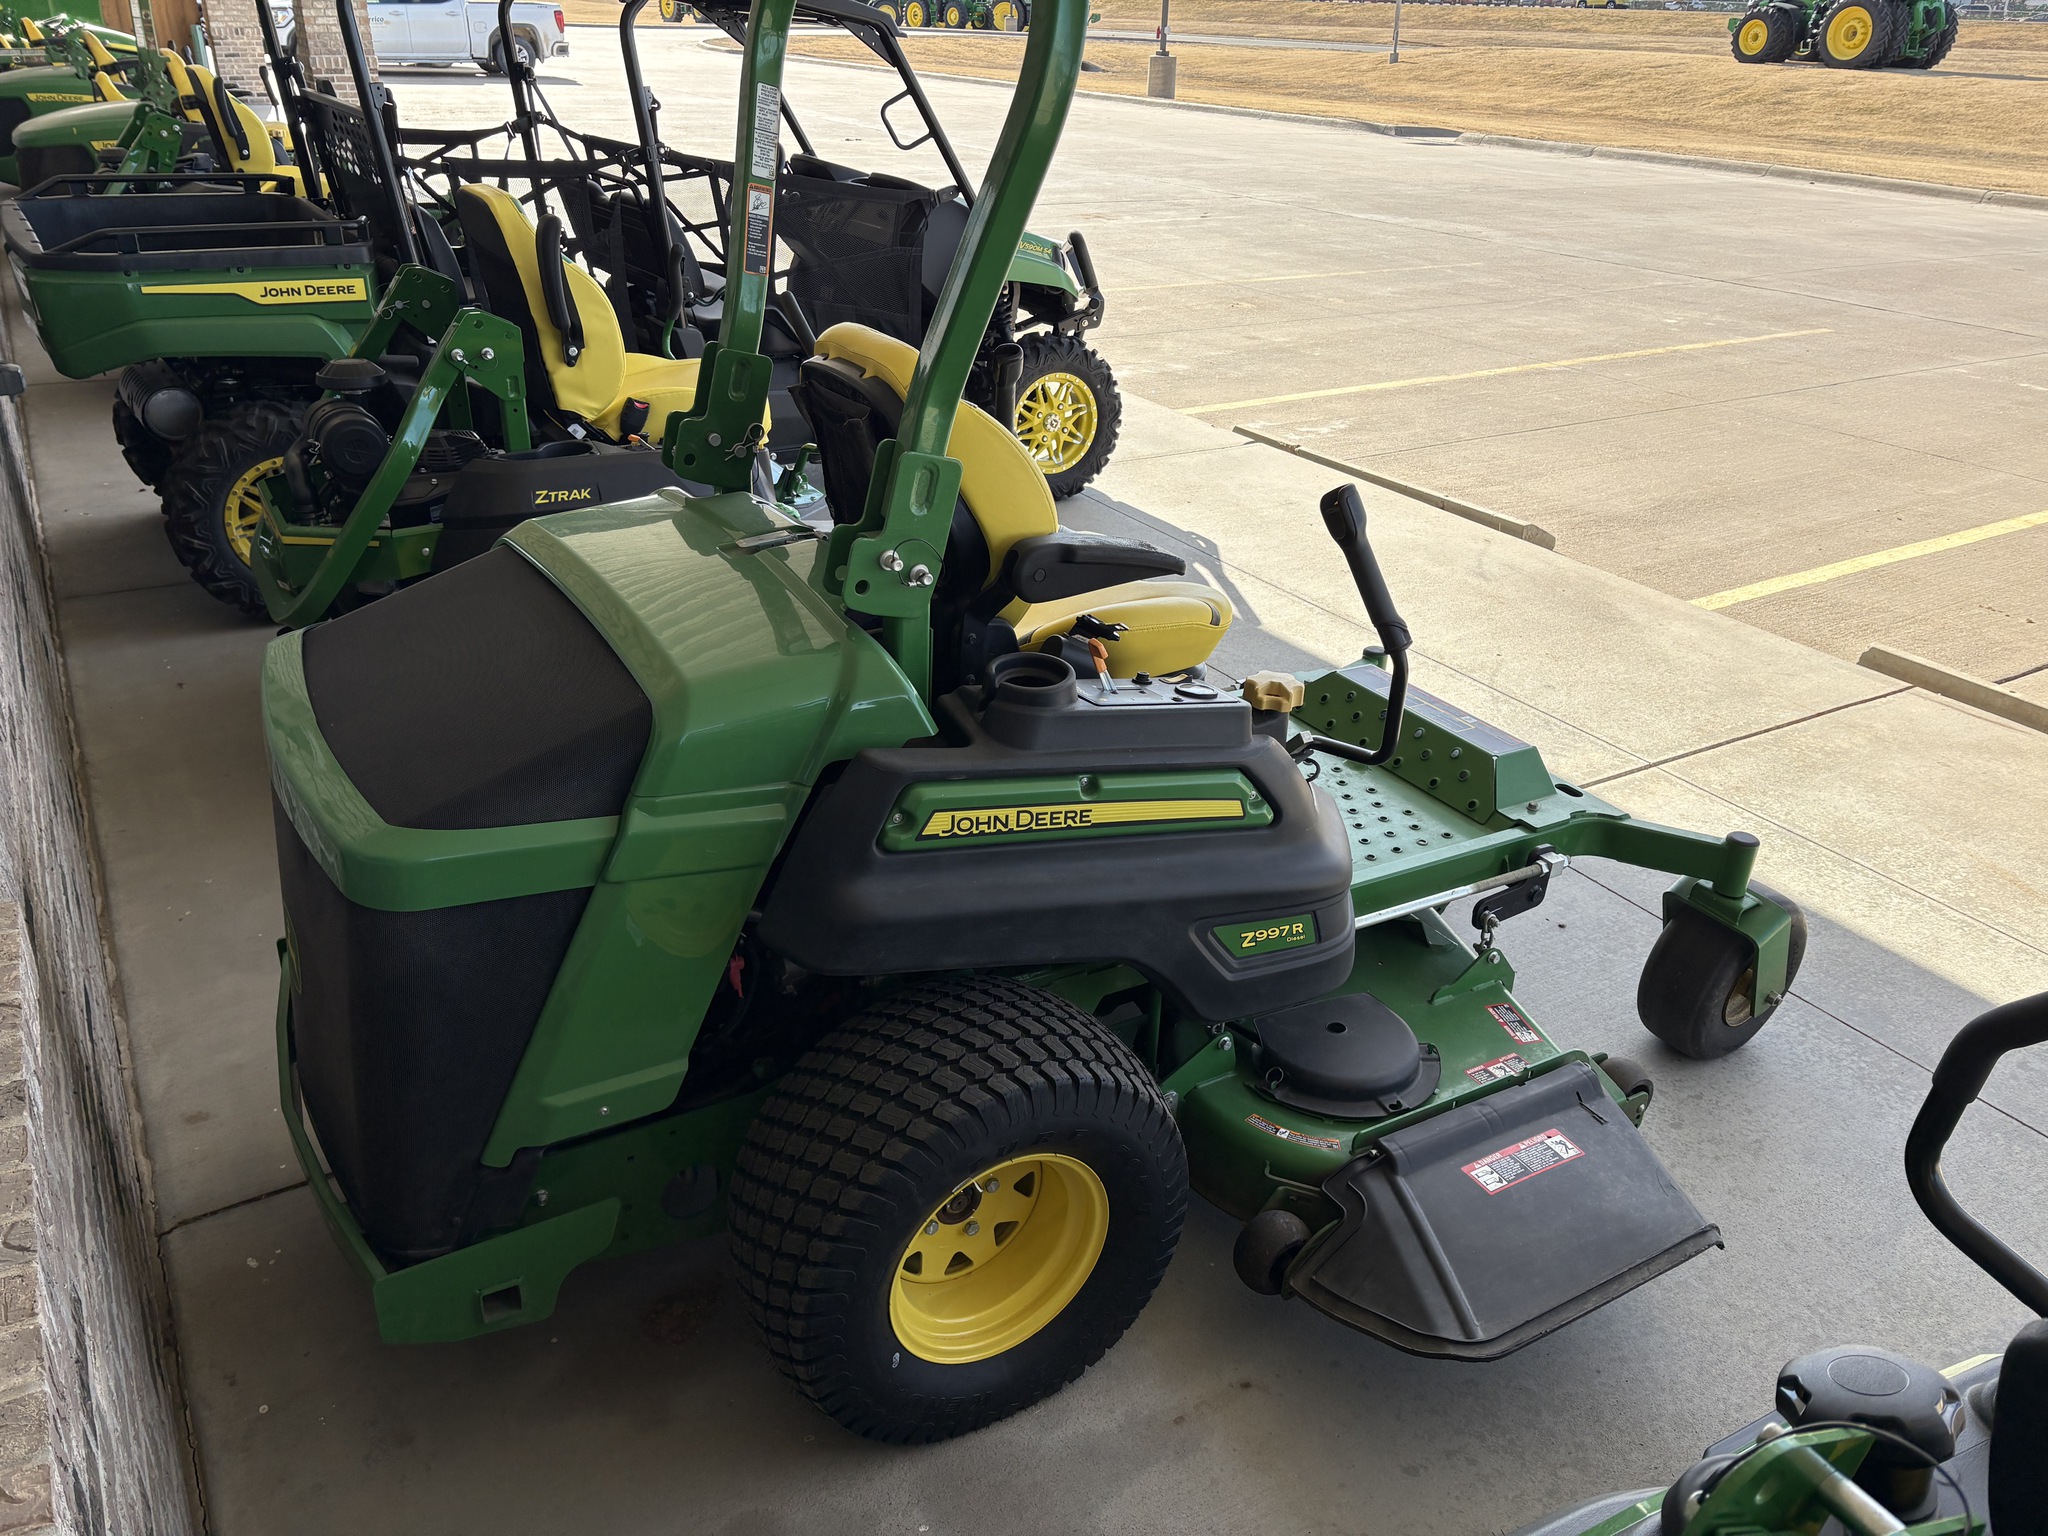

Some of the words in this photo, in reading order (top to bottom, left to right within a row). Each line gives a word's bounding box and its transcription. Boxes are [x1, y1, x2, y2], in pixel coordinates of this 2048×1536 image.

[260, 286, 302, 298] JOHN
[304, 284, 356, 296] DEERE
[534, 488, 591, 504] ZTRAK
[941, 814, 1010, 834] JOHN
[1015, 809, 1093, 829] DEERE
[1240, 922, 1304, 948] Z997R
[1286, 934, 1306, 942] Diesel
